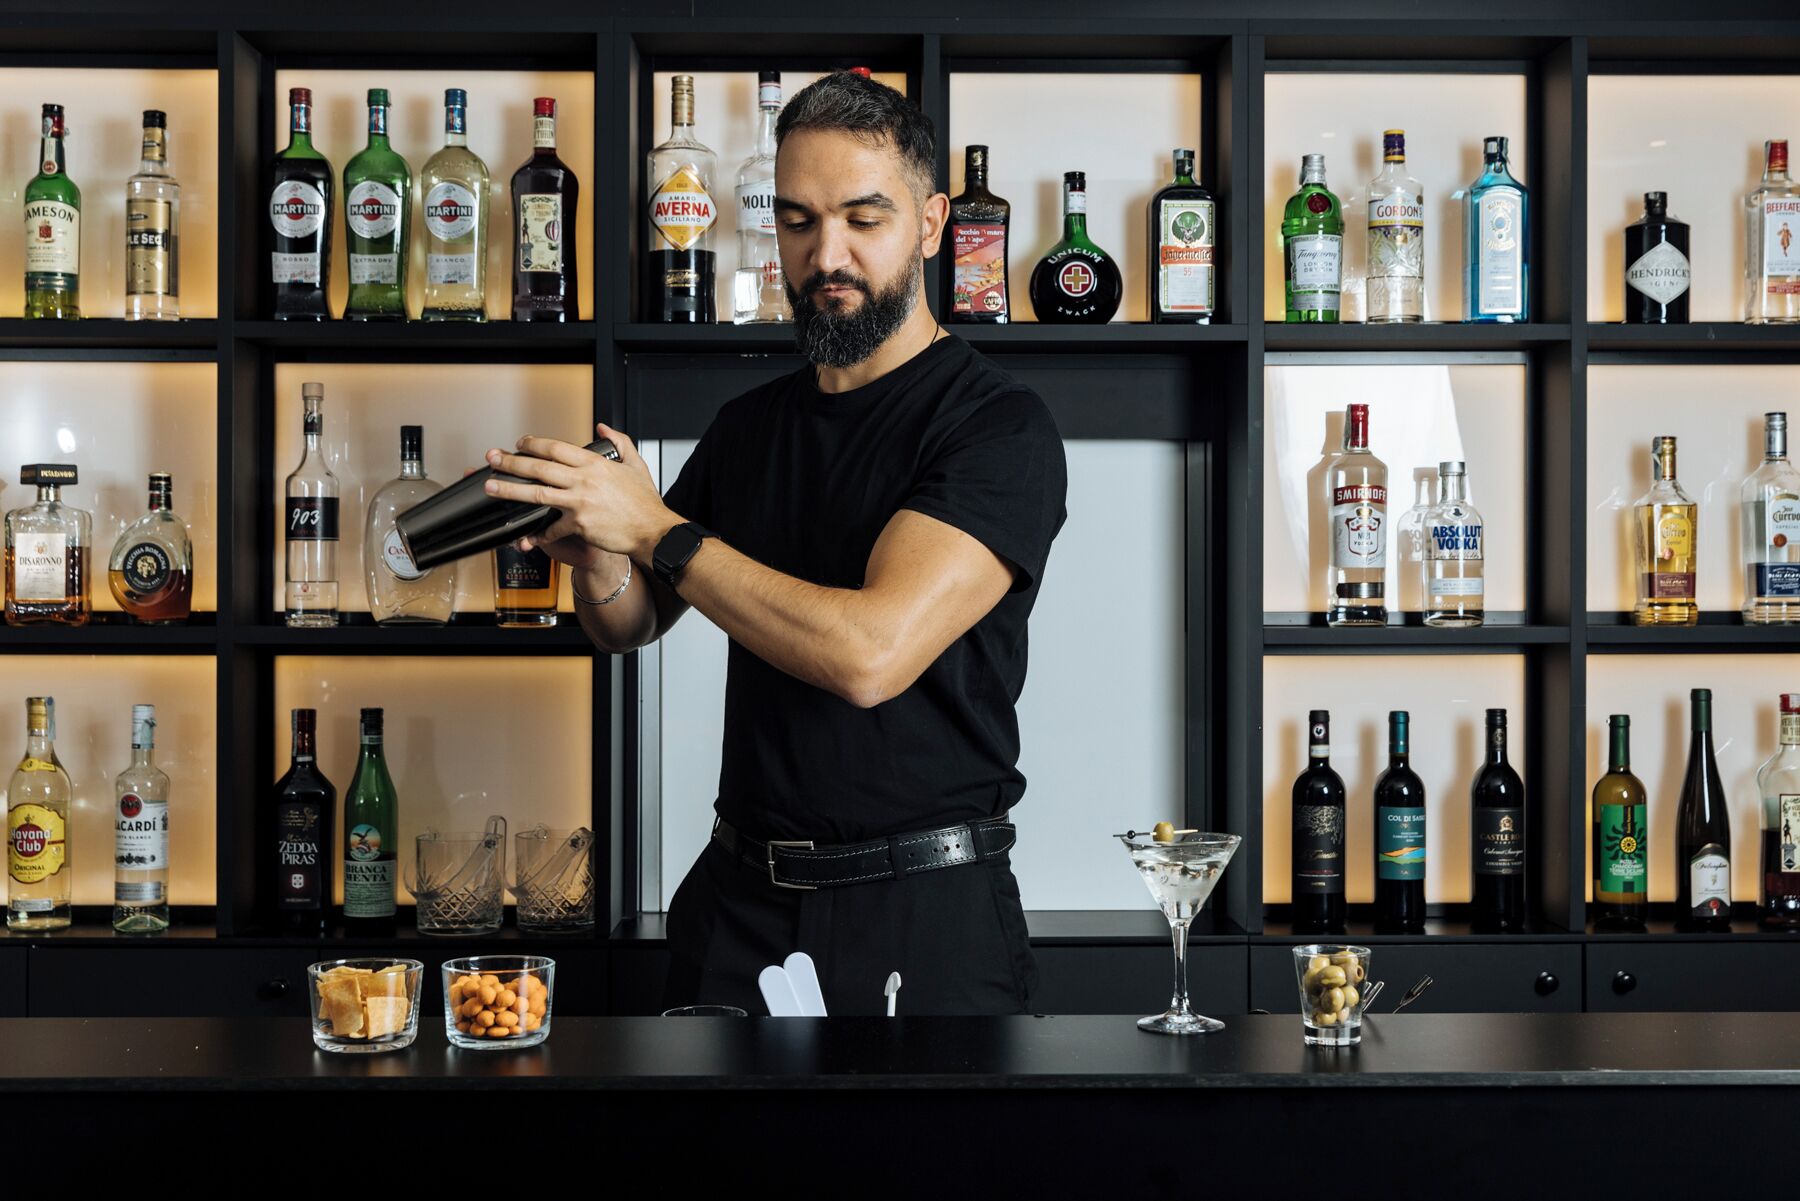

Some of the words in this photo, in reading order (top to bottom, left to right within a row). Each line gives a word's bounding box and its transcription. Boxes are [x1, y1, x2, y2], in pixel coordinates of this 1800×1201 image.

[274, 204, 319, 215] MARTINI
[351, 205, 395, 215] MARTINI
[428, 206, 472, 216] MARTINI
[655, 202, 710, 218] AVERNA
[1047, 248, 1101, 264] UNICUM
[1058, 306, 1096, 316] ZWACK
[291, 508, 320, 530] 903
[1432, 525, 1482, 538] ABSOLUT
[1438, 538, 1478, 550] VODKA
[20, 557, 62, 566] DISARONNO
[115, 817, 156, 831] ACARDÍ
[1387, 814, 1402, 822] COL
[11, 827, 51, 840] Havana
[16, 840, 42, 852] Club
[279, 840, 318, 853] ZEDDA
[282, 852, 315, 865] PIRAS
